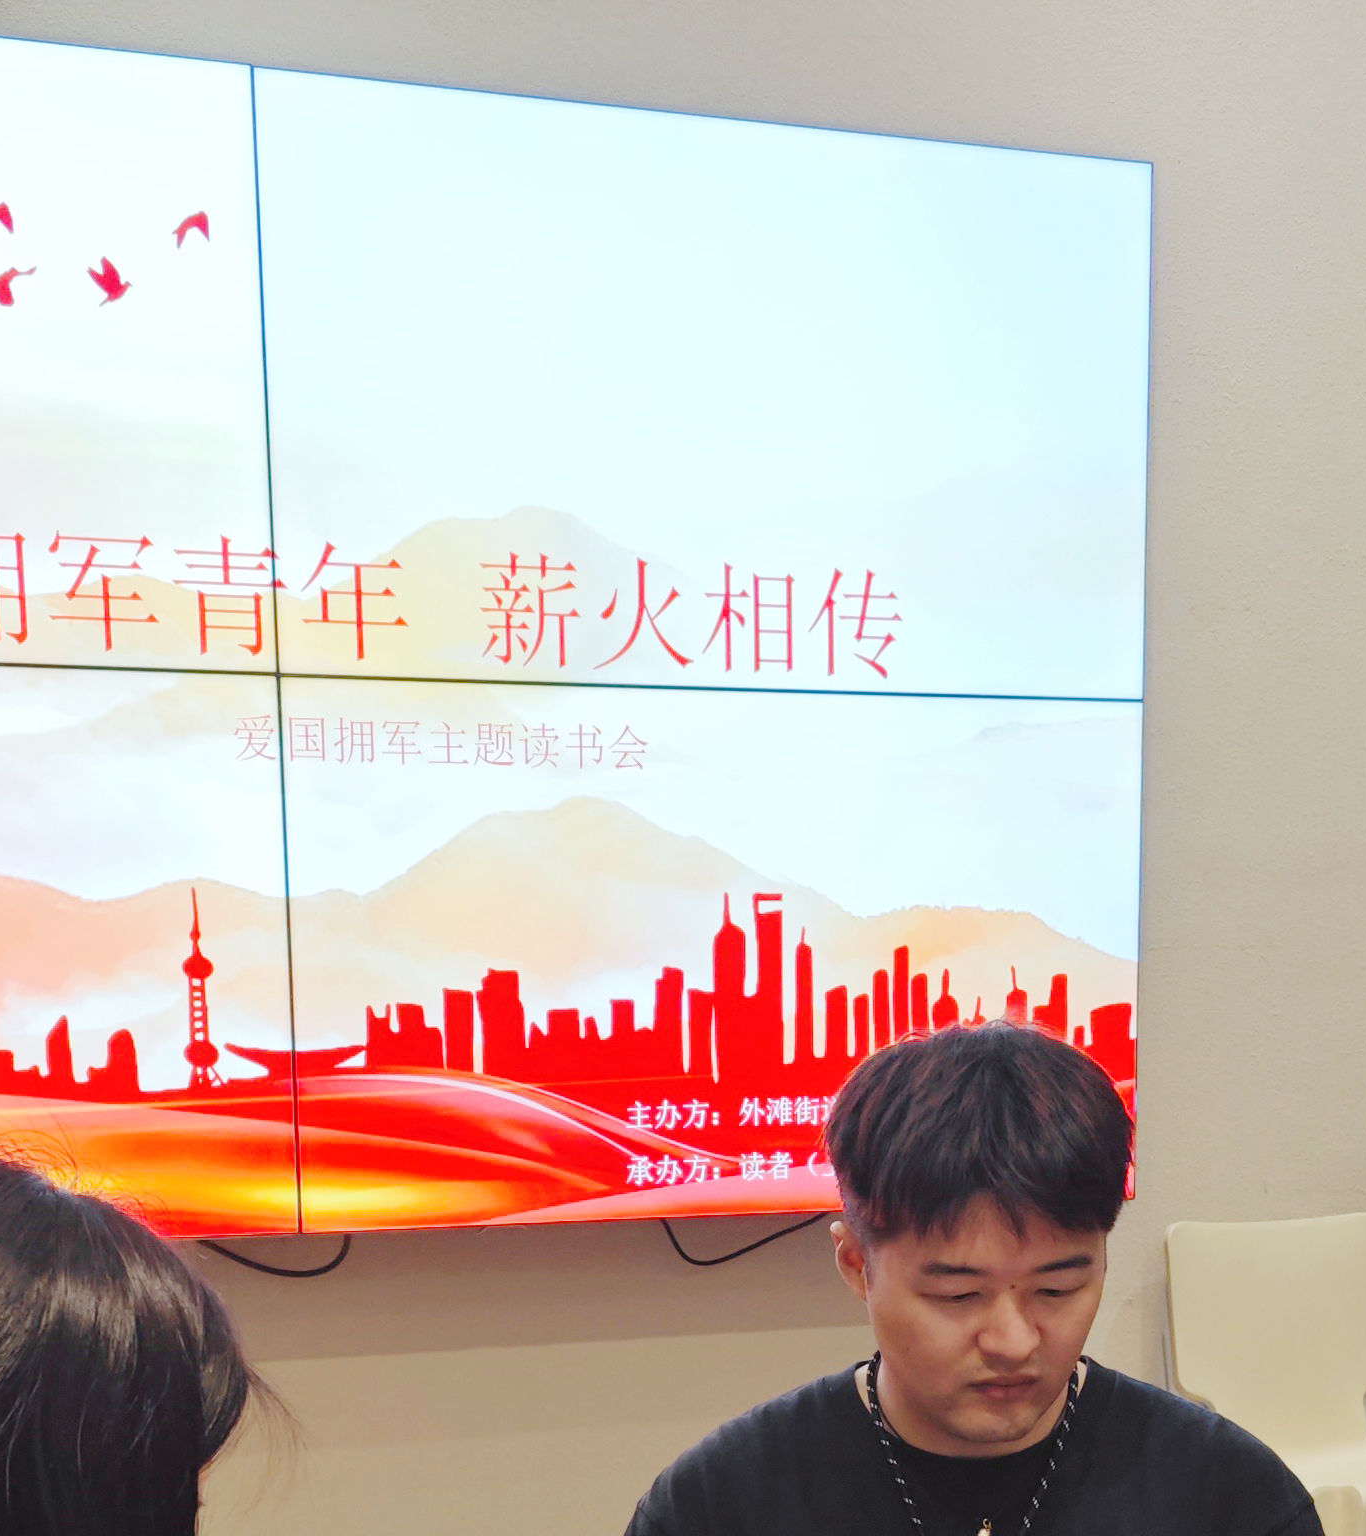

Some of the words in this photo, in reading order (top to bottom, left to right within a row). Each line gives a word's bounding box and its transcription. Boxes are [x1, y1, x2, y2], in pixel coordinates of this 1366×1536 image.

[479, 552, 904, 680] 薪火相传
[233, 714, 649, 771] 爱国拥军主题读书会
